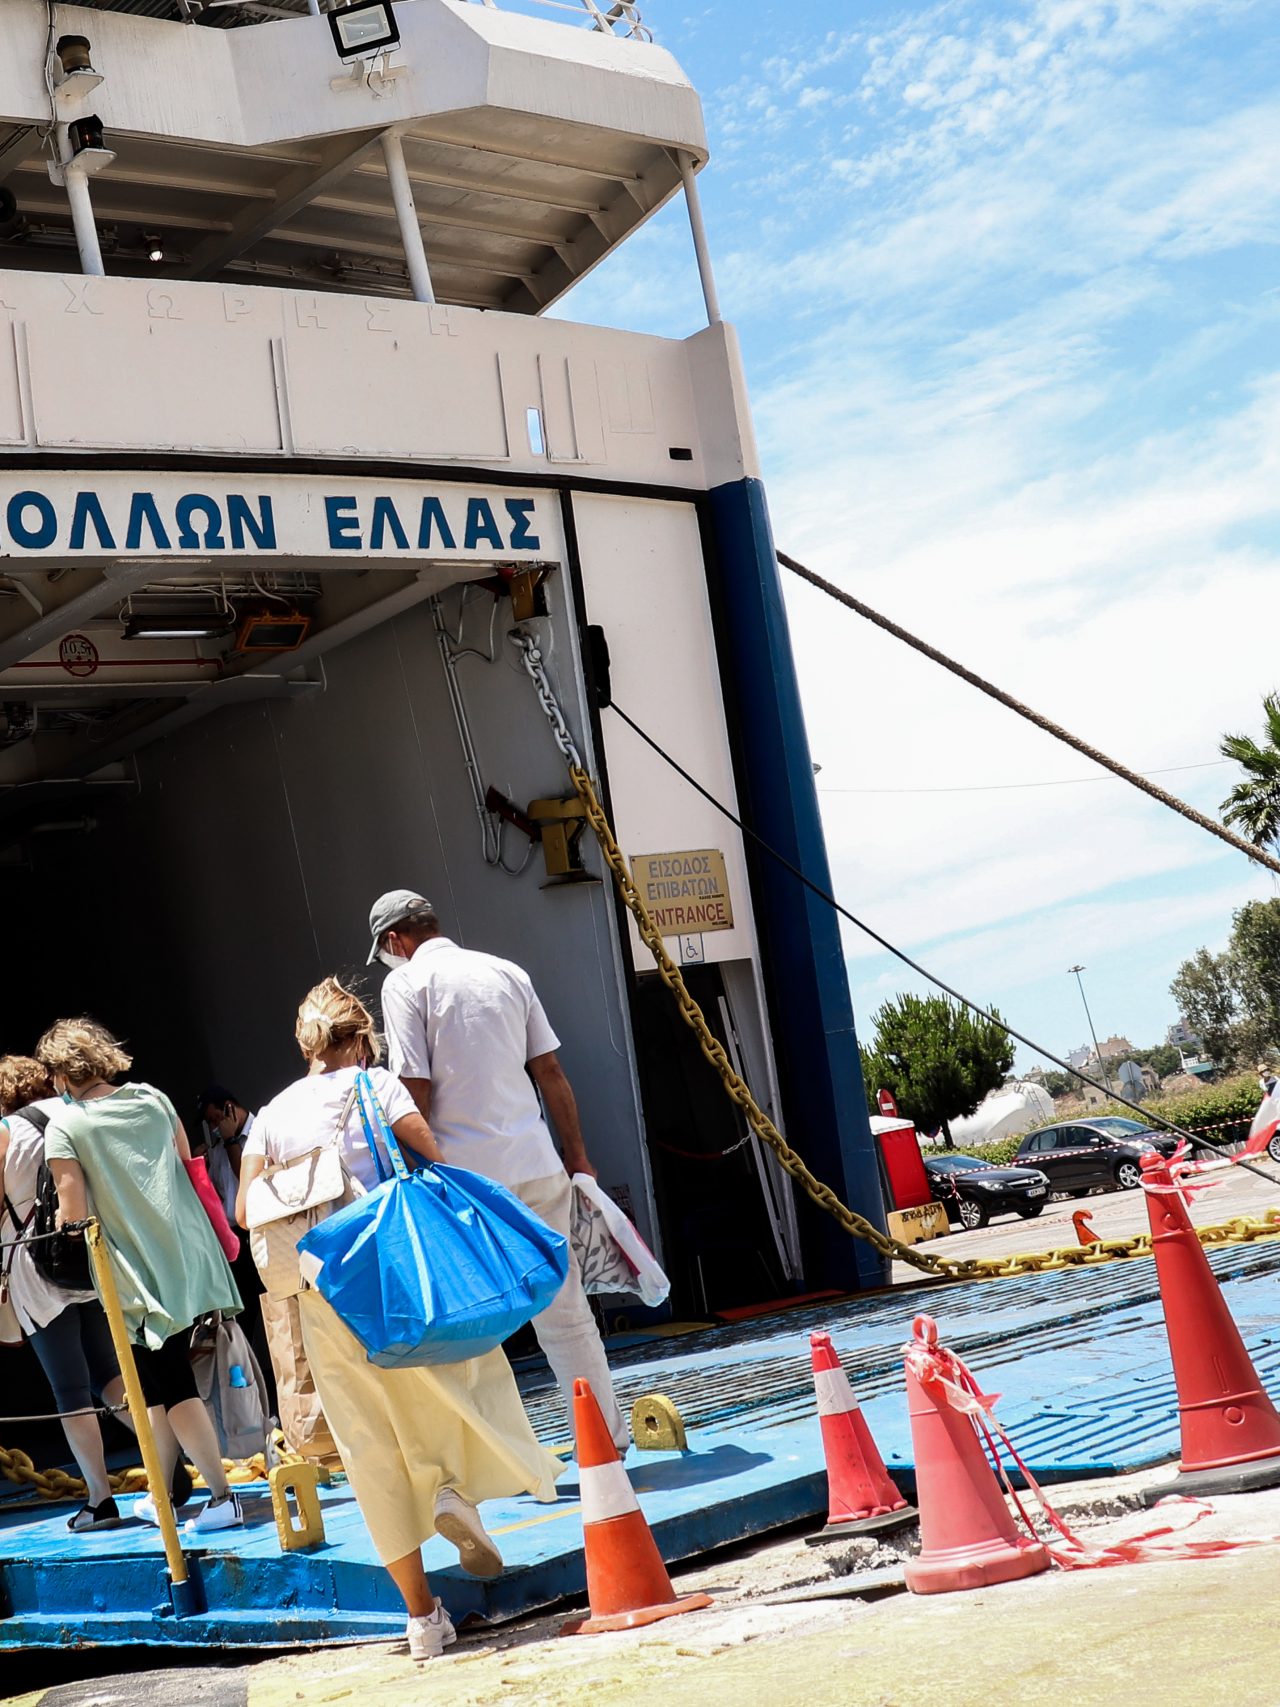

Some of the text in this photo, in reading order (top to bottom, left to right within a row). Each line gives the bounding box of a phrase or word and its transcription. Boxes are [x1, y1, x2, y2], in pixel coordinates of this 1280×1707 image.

[324, 496, 540, 550] ΕΛΛΑΣ
[648, 856, 711, 878] ΕΙΣΟΔΟΣ
[647, 877, 719, 901] ΕΠΙΒΑΤΩΝ
